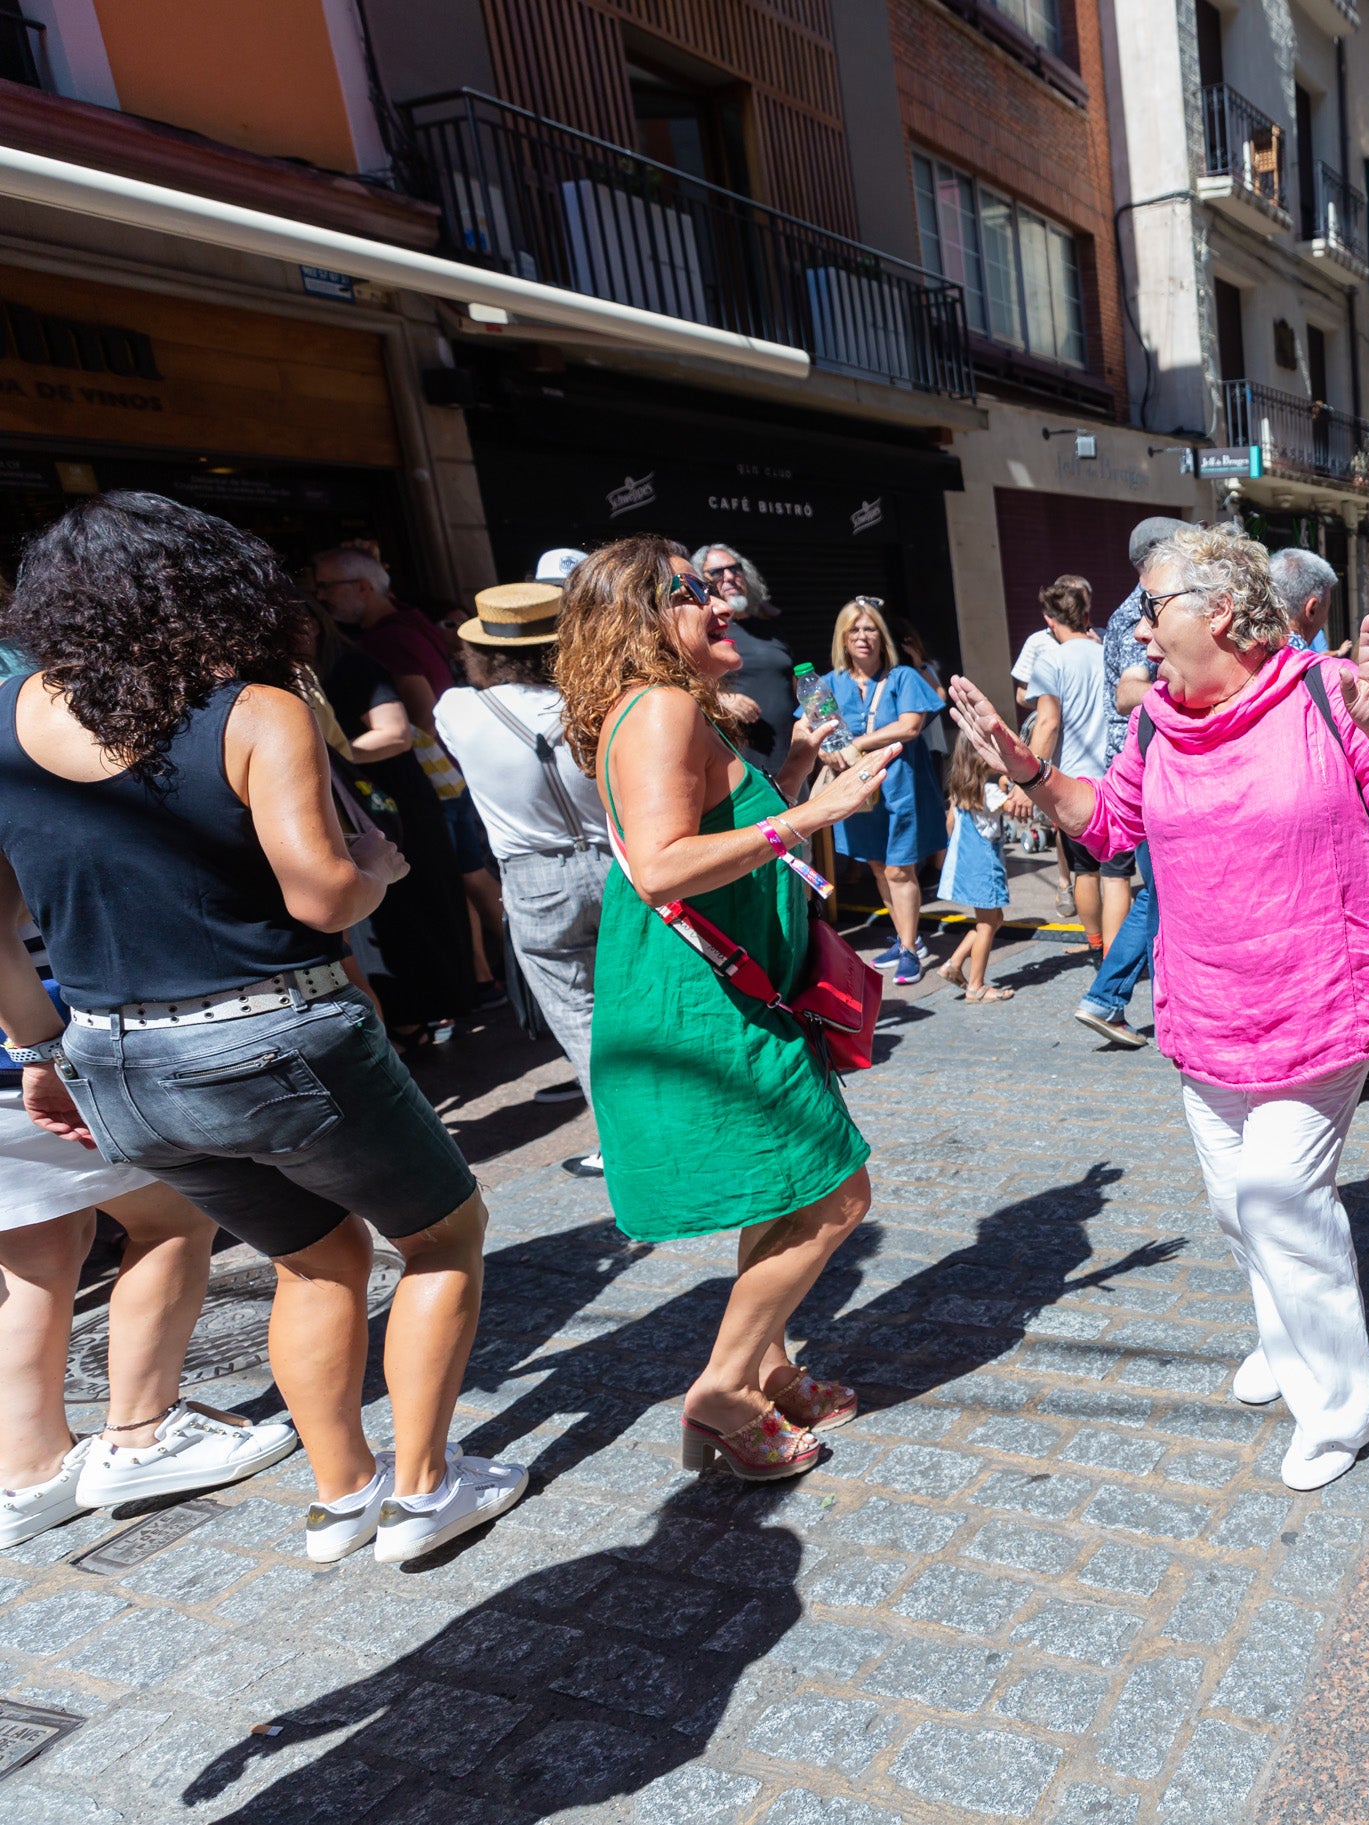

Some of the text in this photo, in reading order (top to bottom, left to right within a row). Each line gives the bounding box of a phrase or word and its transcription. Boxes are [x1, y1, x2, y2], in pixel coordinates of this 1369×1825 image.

[36, 381, 74, 404] DE
[79, 387, 163, 412] VINOS
[708, 495, 751, 514] CAFÉ
[113, 1515, 173, 1550] LLAVE
